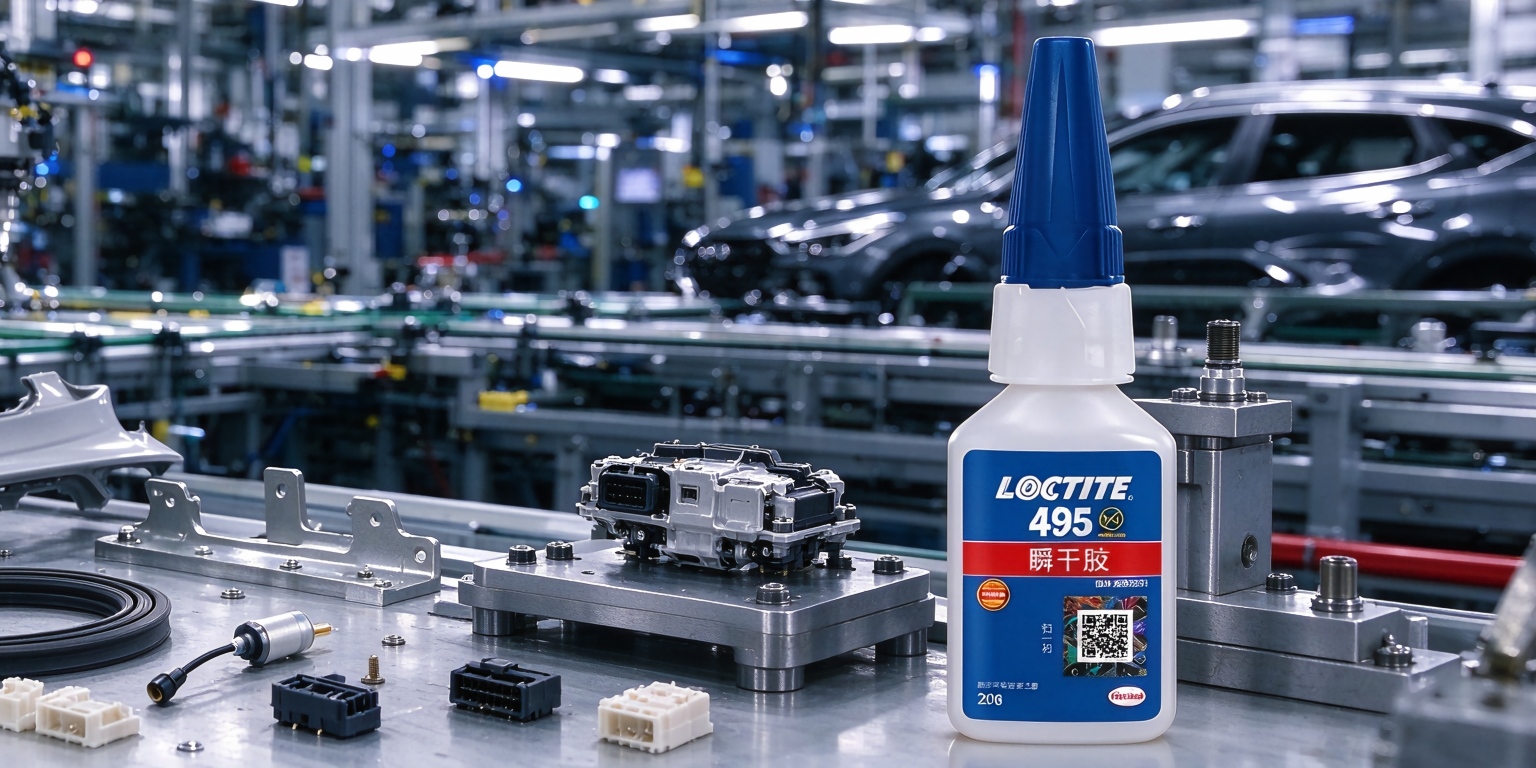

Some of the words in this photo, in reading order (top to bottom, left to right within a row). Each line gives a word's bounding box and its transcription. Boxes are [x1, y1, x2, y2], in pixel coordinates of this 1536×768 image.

[995, 475, 1133, 501] LOCTITE
[1029, 506, 1093, 537] 495
[1029, 547, 1111, 573] 瞬干胶
